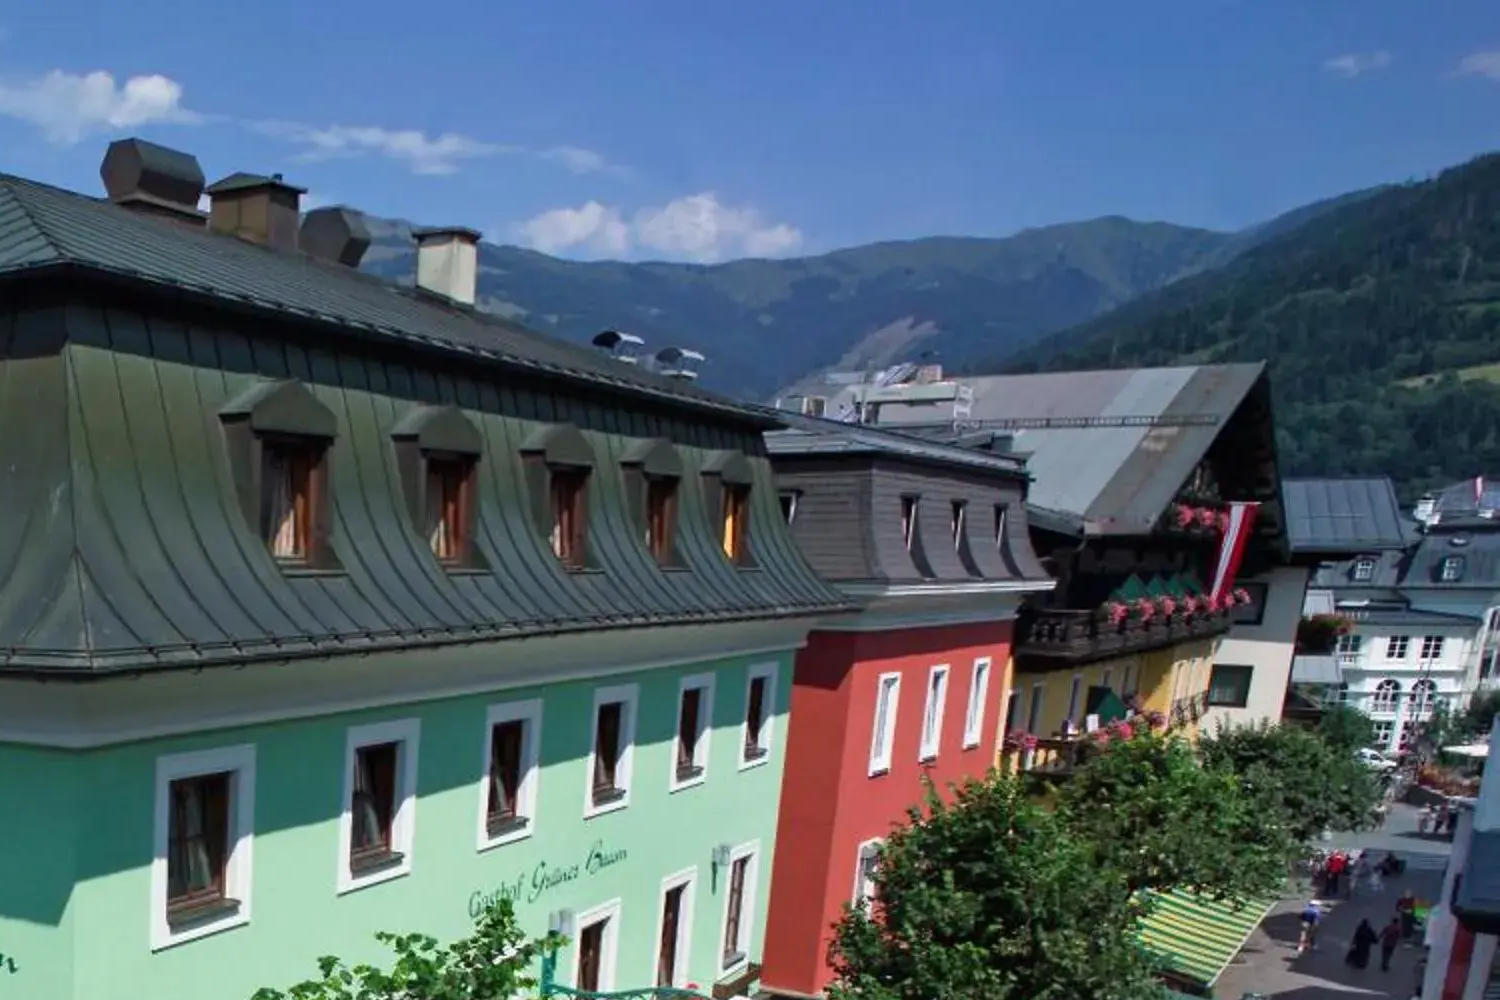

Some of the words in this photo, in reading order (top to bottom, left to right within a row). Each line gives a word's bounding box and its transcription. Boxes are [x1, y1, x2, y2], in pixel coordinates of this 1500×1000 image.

[468, 873, 525, 918] Gasthof
[528, 860, 579, 903] Grüner
[585, 839, 627, 875] Baum
